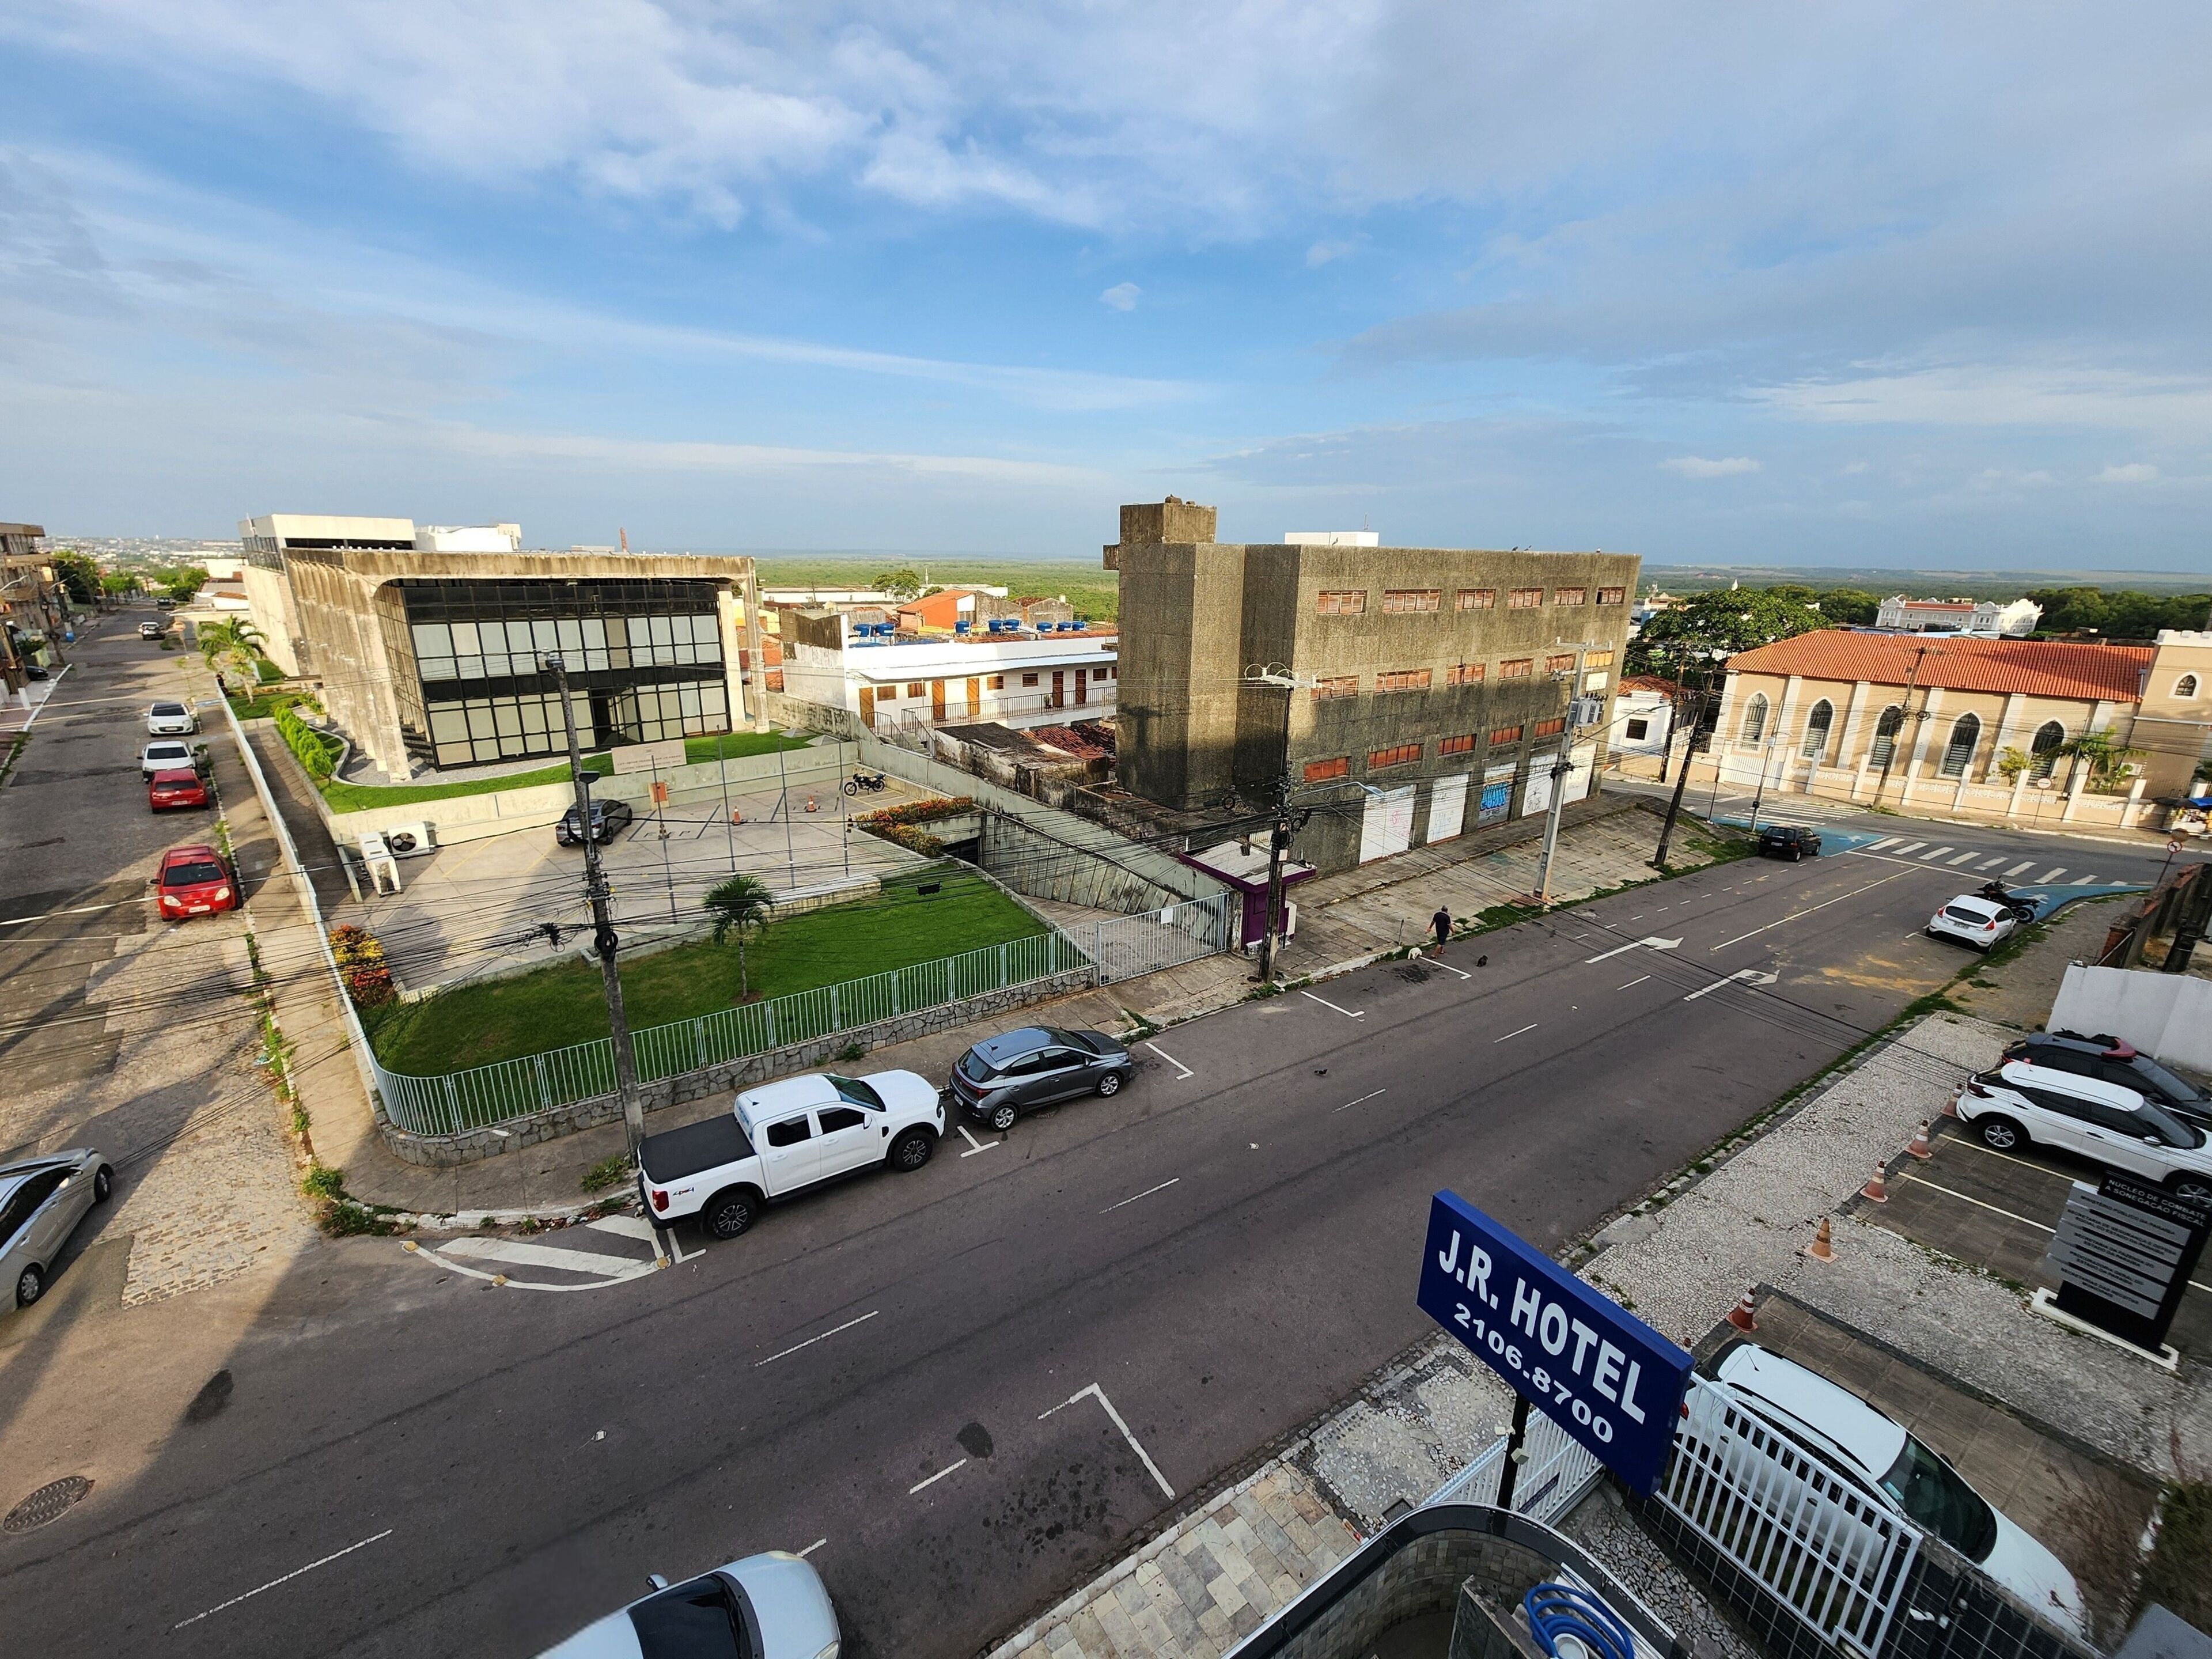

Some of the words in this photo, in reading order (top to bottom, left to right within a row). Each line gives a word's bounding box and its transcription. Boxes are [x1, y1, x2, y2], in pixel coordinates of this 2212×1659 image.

[2146, 1194, 2160, 1202] DE
[2161, 1199, 2207, 1220] COMBATE
[2172, 1211, 2206, 1227] FISCAL
[1438, 1230, 1498, 1310] J.R.
[1510, 1277, 1646, 1425] HOTEL
[1454, 1302, 1614, 1444] 2106.8700
